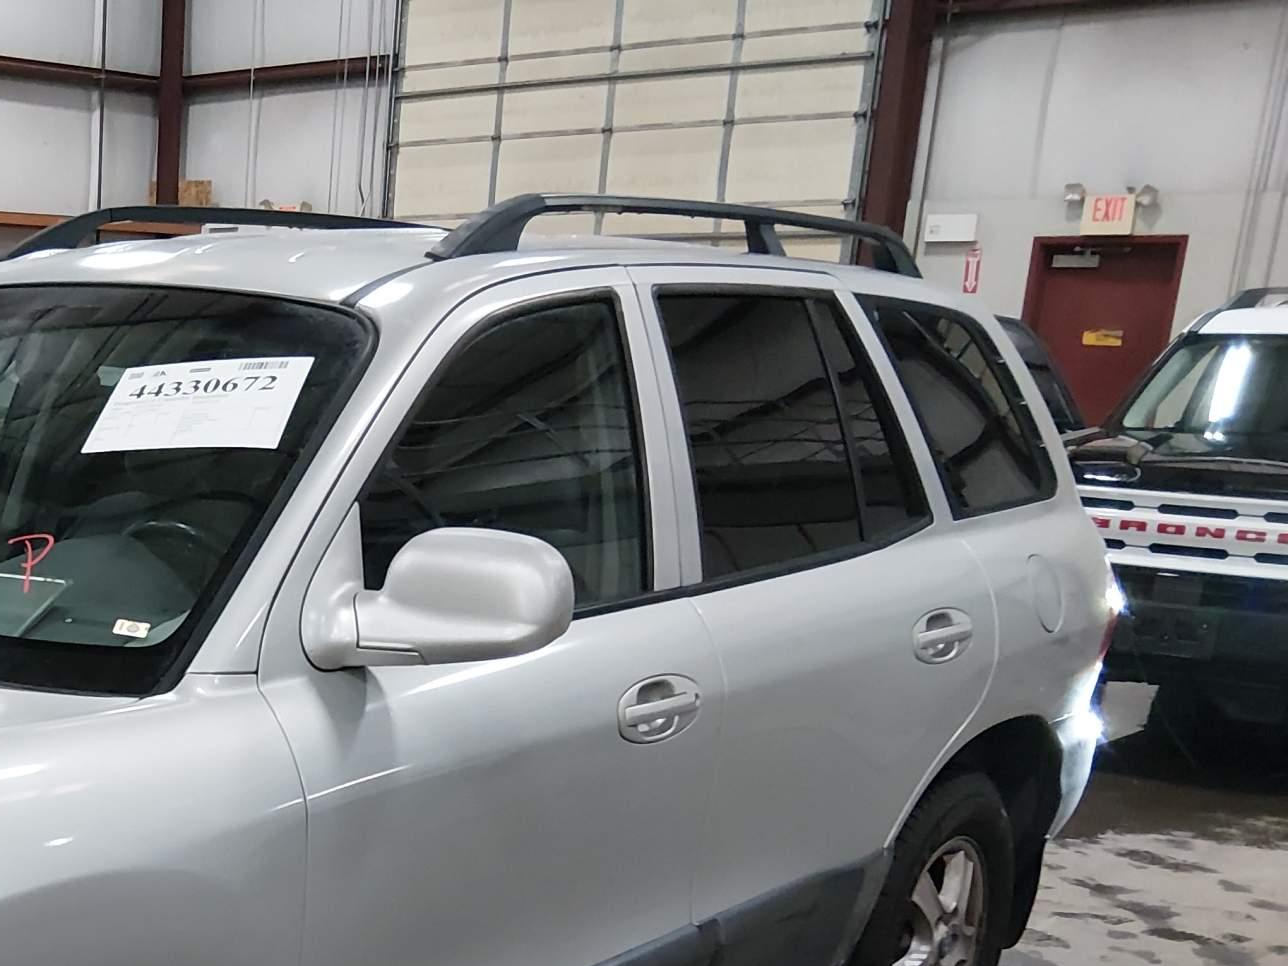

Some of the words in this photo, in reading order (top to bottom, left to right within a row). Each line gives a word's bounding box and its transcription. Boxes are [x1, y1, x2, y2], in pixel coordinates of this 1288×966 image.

[1092, 196, 1129, 222] EXIT
[128, 374, 279, 400] 44330672
[7, 533, 55, 593] P
